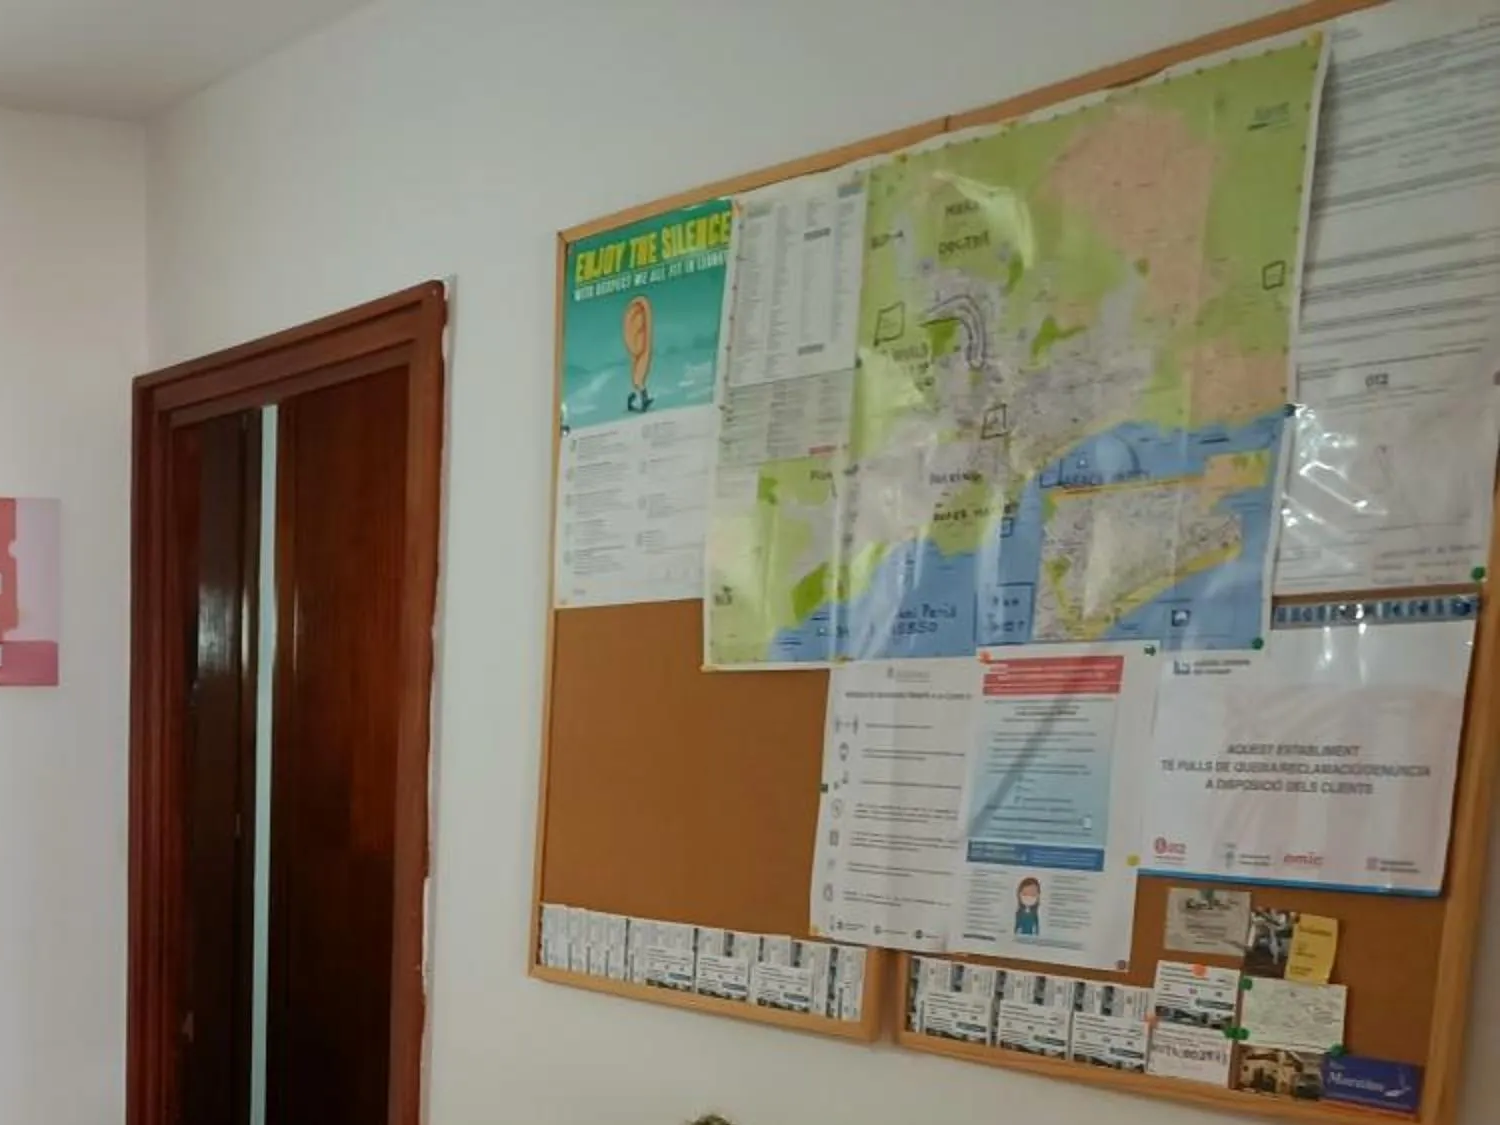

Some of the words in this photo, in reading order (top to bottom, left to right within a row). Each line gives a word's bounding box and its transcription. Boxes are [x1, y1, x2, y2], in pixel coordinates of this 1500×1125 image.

[575, 241, 626, 288] ENJOY
[628, 231, 658, 270] THE
[661, 210, 731, 260] SILENCE
[1215, 761, 1231, 772] DE
[1204, 779, 1214, 790] A
